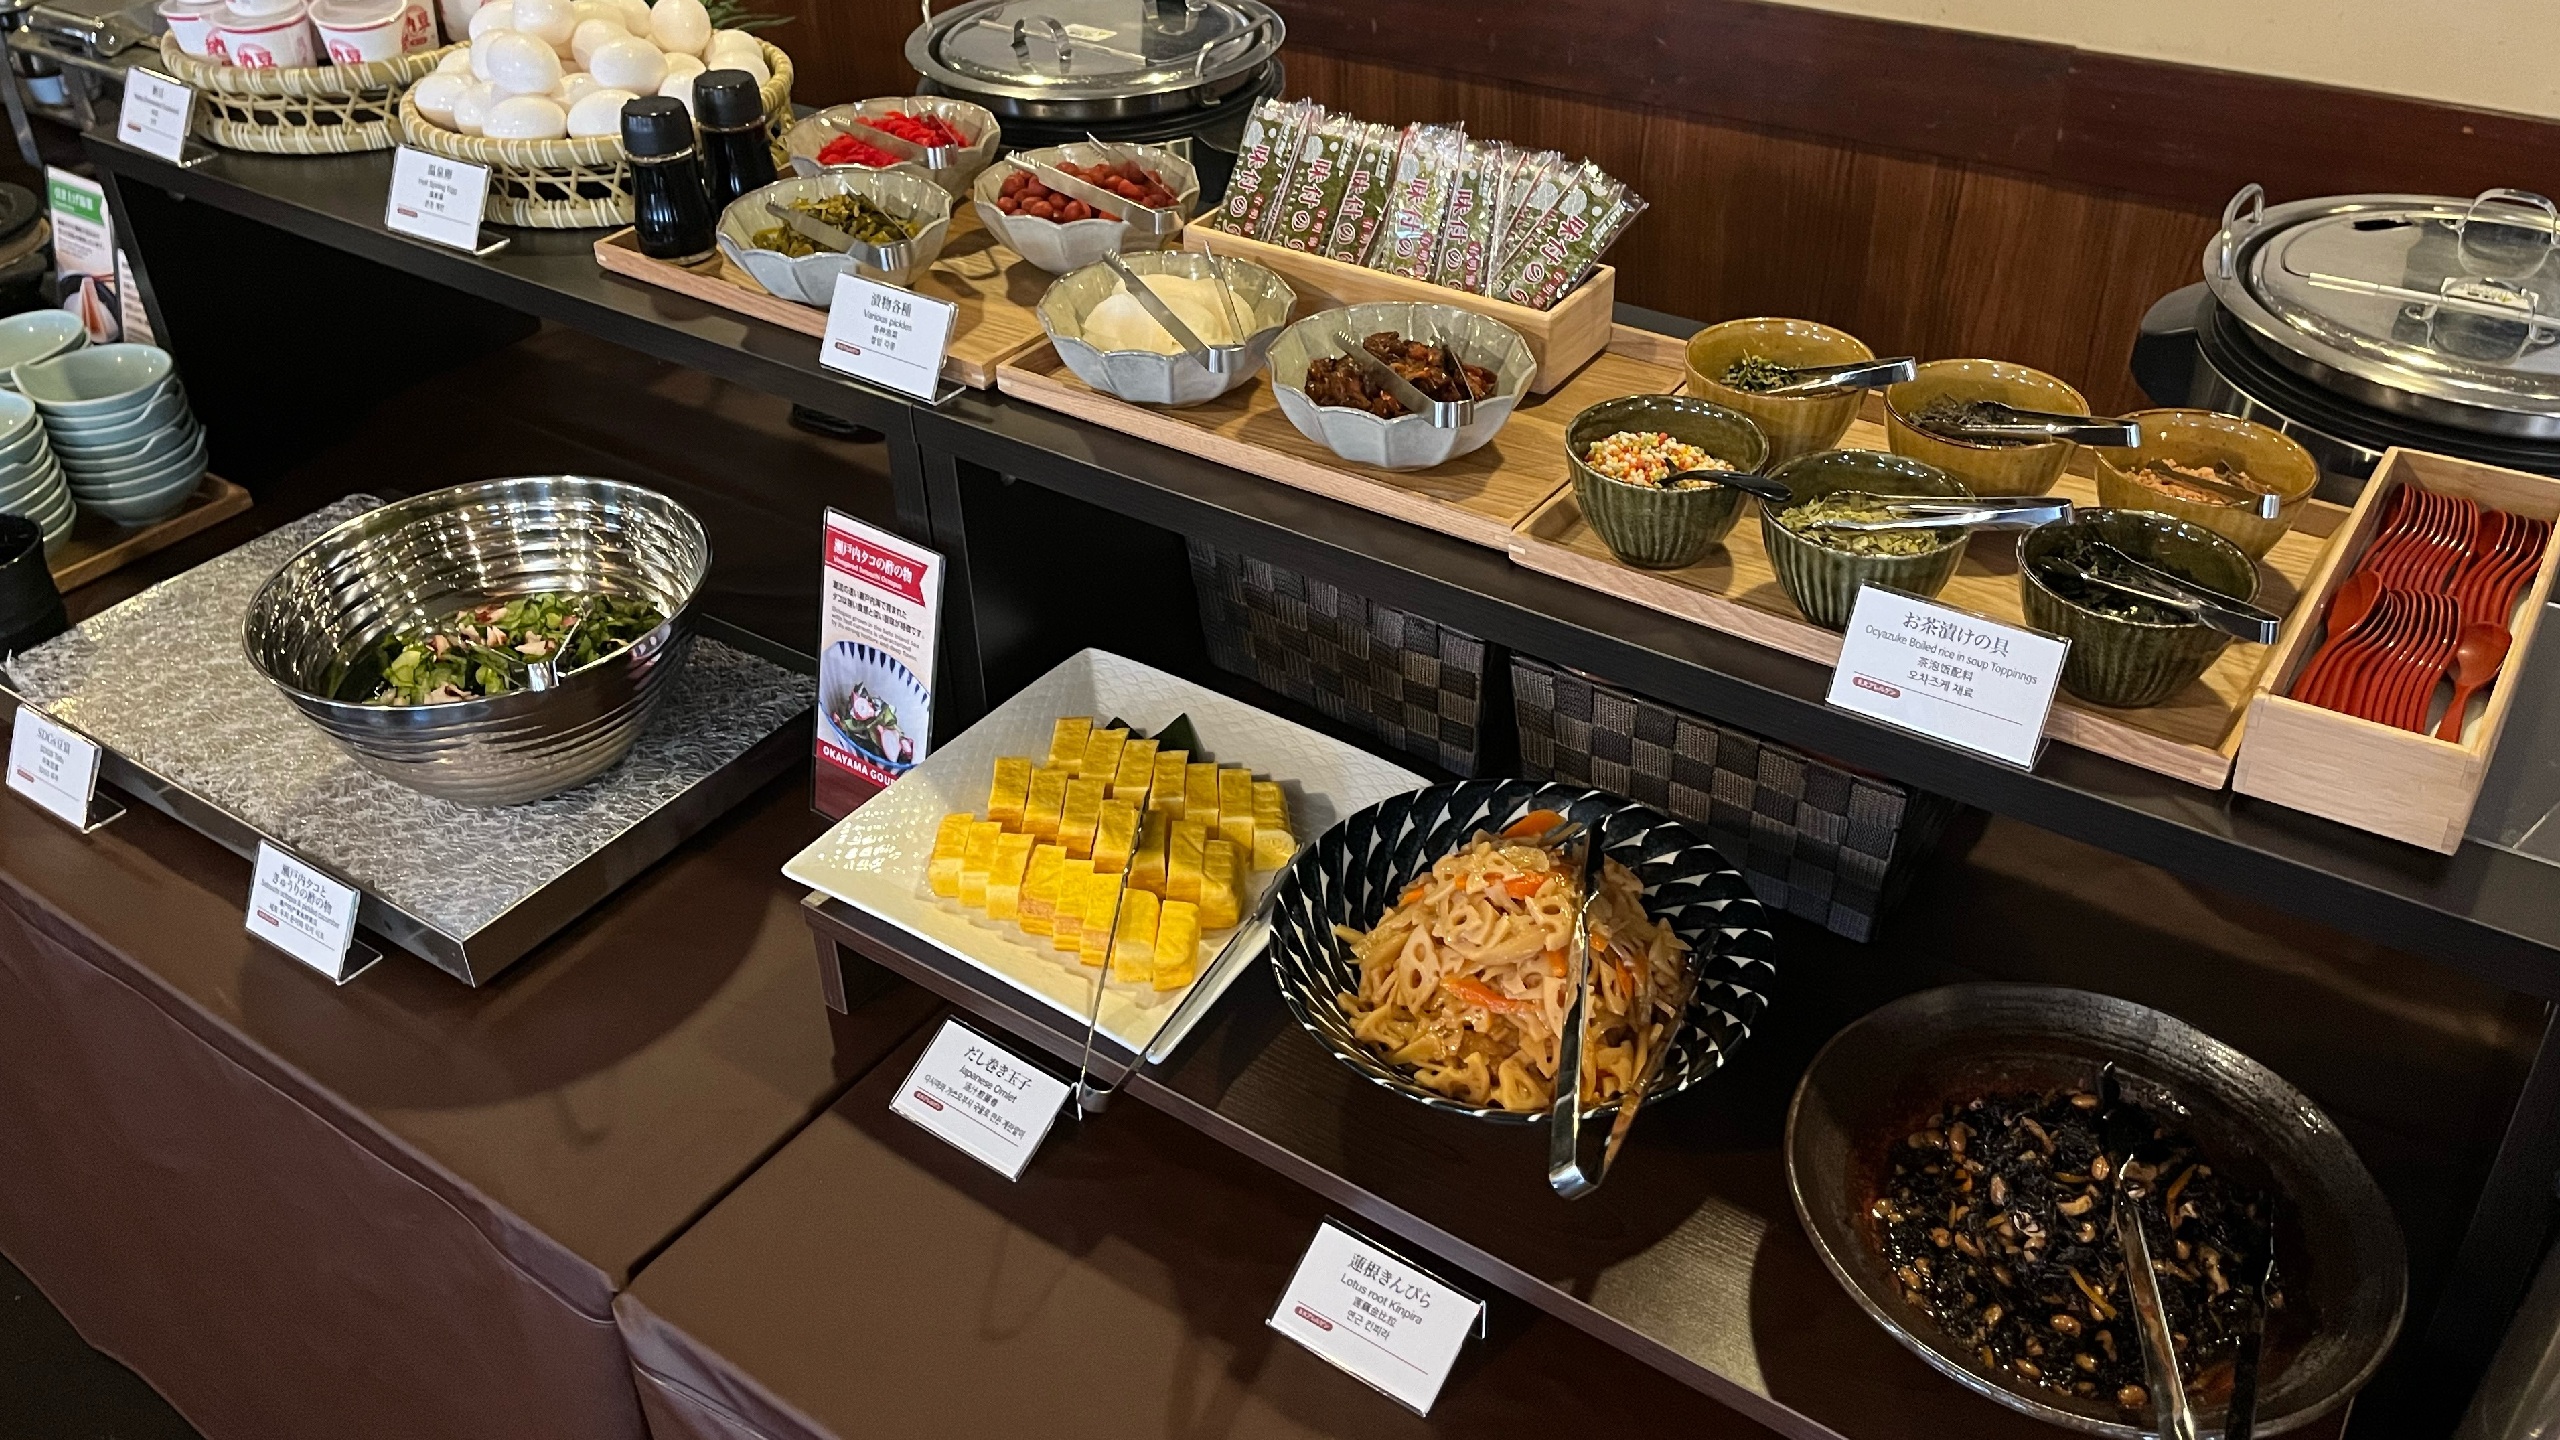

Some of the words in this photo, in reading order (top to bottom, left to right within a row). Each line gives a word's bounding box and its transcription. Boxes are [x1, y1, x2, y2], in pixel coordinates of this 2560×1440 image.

[1507, 214, 1589, 305] 味付のり
[864, 309, 888, 323] Various
[889, 318, 913, 331] pickles
[1903, 611, 2009, 658] お茶漬けの具
[1938, 644, 1954, 659] rice
[1956, 650, 1965, 661] in
[1966, 654, 1988, 670] soup
[823, 745, 868, 776] OKAYAMA
[959, 1065, 993, 1091] Japanese
[964, 1046, 1033, 1091] だし巻き玉子
[1341, 1273, 1367, 1294] Lotus
[1368, 1288, 1388, 1306] root
[1388, 1300, 1423, 1325] Kinpira
[1348, 1253, 1431, 1309] 蓮根きんぴら
[1346, 1310, 1364, 1326] 연근
